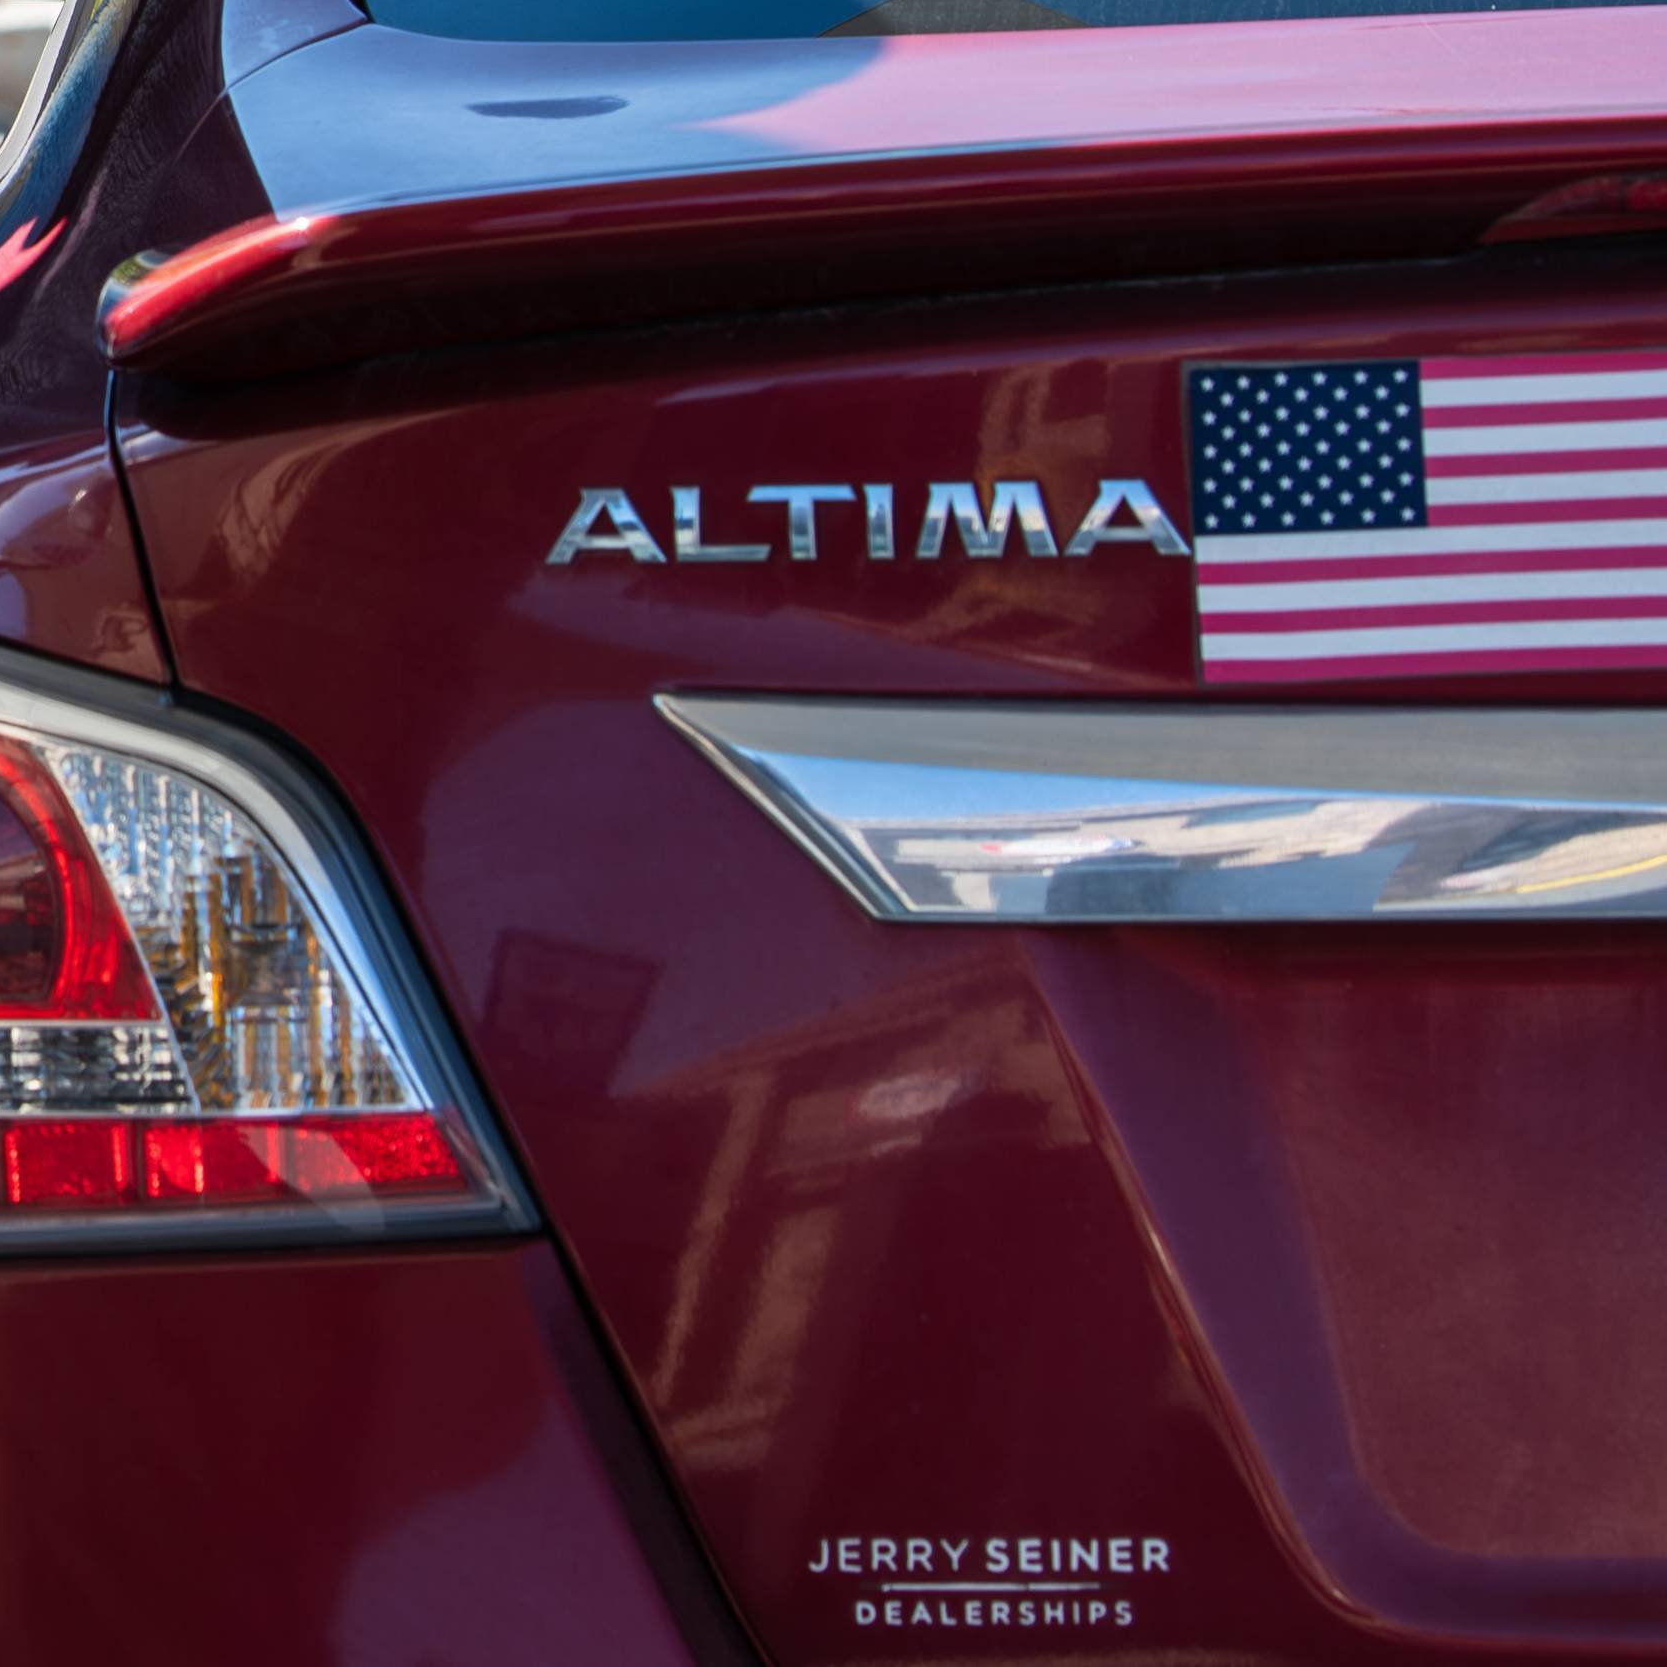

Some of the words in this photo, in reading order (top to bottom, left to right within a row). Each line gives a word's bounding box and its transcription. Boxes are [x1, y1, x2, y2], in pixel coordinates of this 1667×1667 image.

[545, 480, 1192, 563] ALTIMA
[809, 1537, 968, 1573] JERRY
[985, 1537, 1170, 1574] SEINER
[855, 1600, 1133, 1626] DEALERSHIPS
